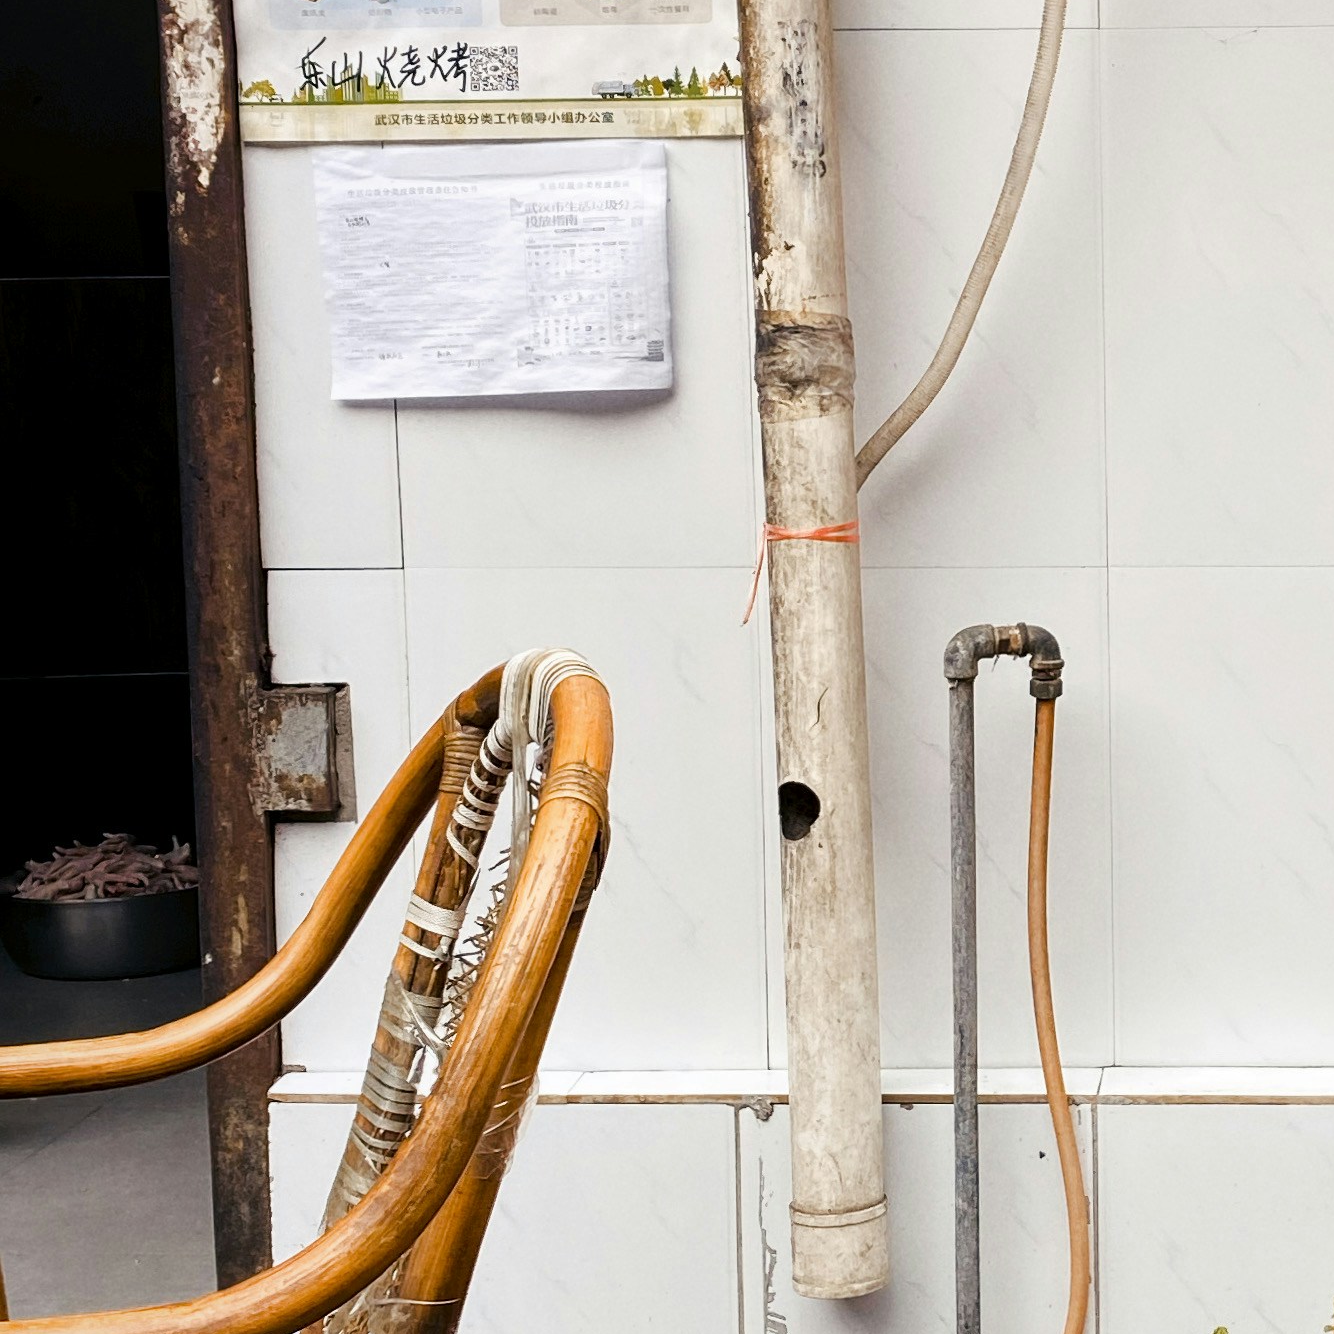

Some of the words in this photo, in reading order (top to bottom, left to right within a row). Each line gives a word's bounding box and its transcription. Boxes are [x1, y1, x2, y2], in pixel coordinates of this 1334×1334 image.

[374, 111, 615, 126] 武汉市生活垃圾分类工作领导小组办公室
